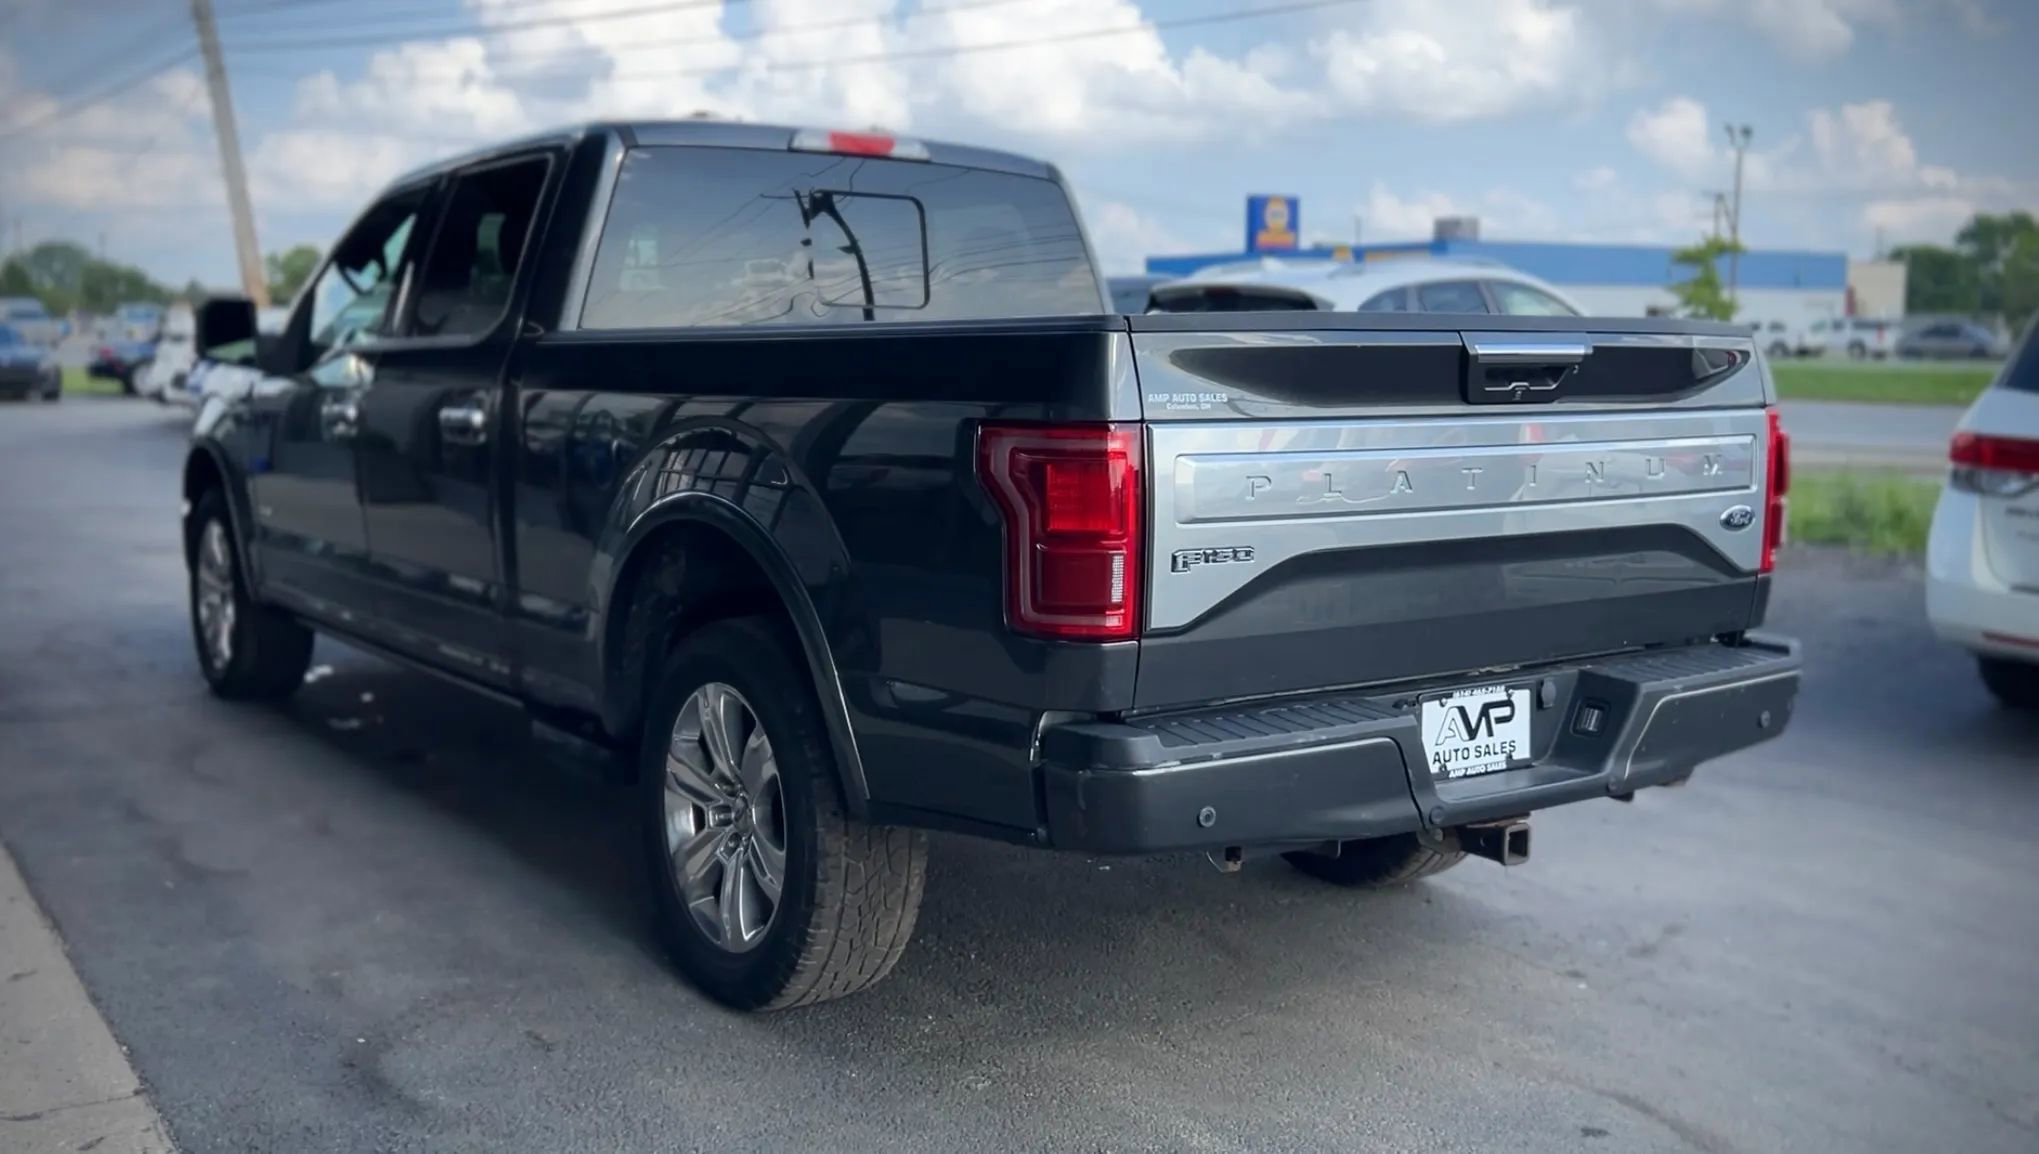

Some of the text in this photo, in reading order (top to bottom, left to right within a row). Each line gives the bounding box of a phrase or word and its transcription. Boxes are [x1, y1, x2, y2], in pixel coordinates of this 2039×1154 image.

[1148, 392, 1228, 402] AMP AUTO SALES
[1246, 454, 1723, 501] PLATINUM
[1432, 740, 1516, 765] AUTO SALES
